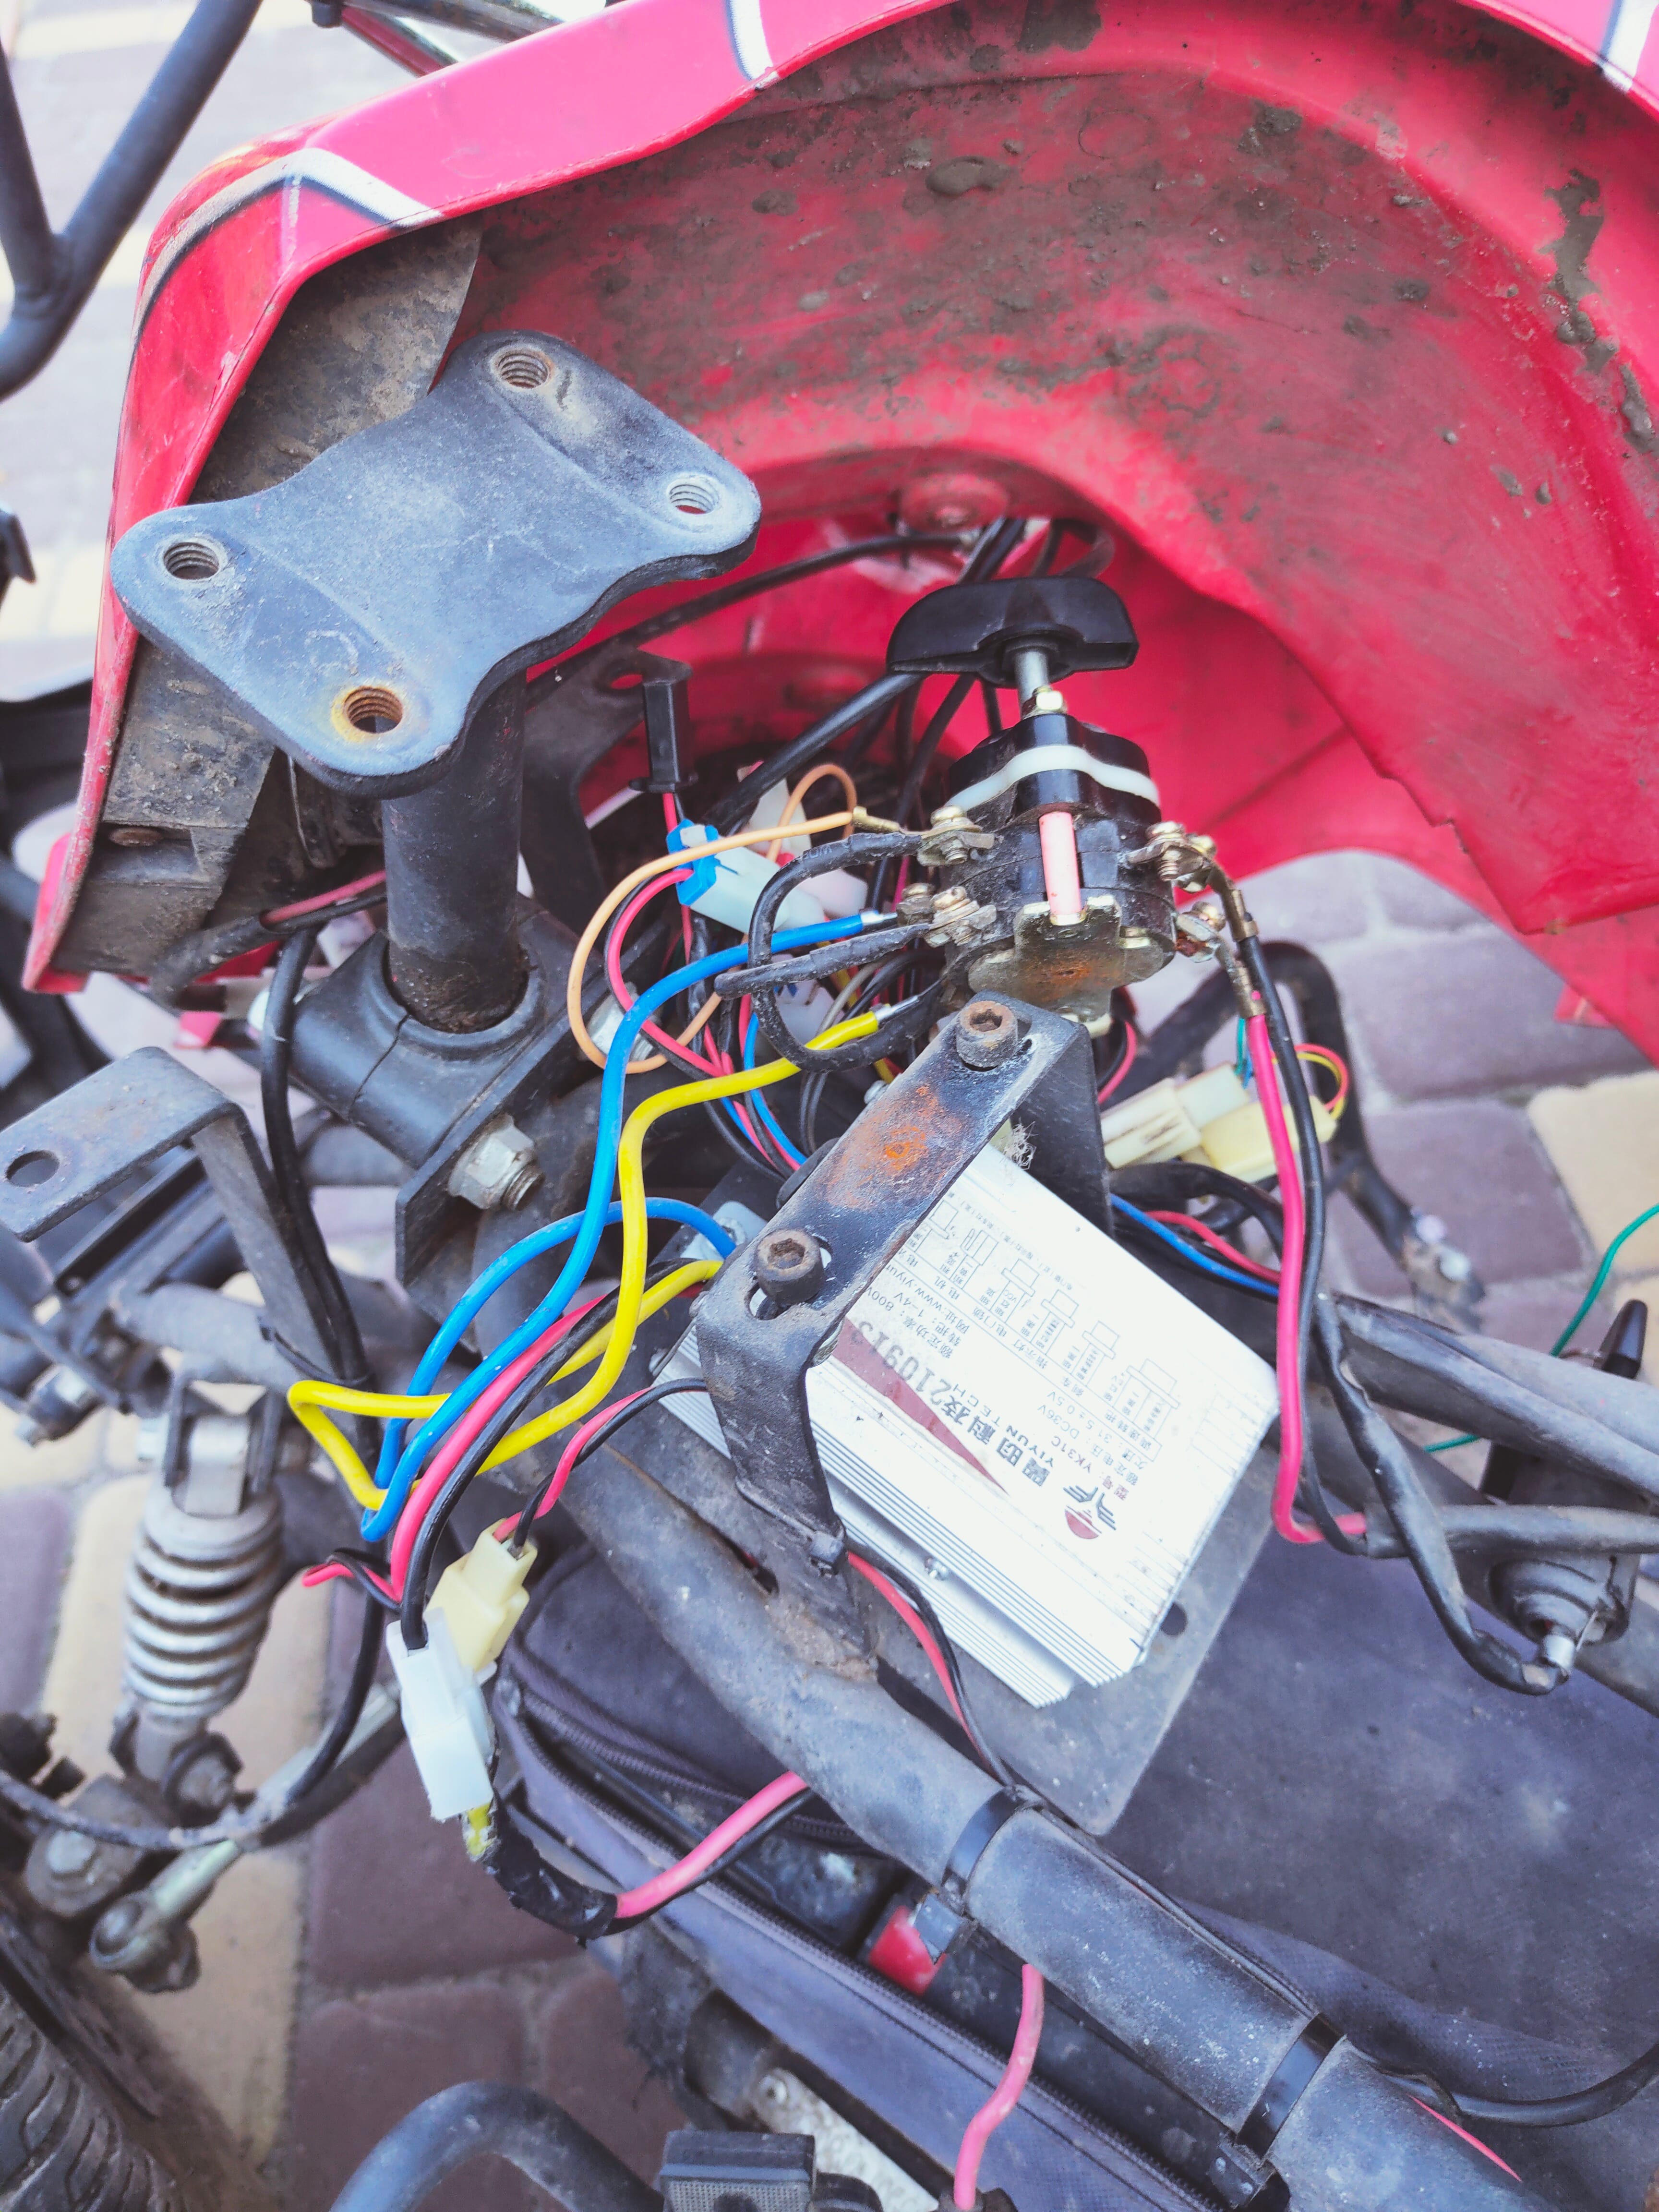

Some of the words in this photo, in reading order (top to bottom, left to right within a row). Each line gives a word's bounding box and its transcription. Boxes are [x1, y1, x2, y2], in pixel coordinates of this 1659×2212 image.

[933, 1275, 960, 1301] 电机
[971, 1306, 1008, 1338] 电门锁
[848, 1318, 952, 1407] 210913
[951, 1382, 1003, 1427] TECH
[1036, 1402, 1080, 1439] DC36V
[1004, 1424, 1055, 1467] YIYUN
[1049, 1434, 1094, 1473] YK31C
